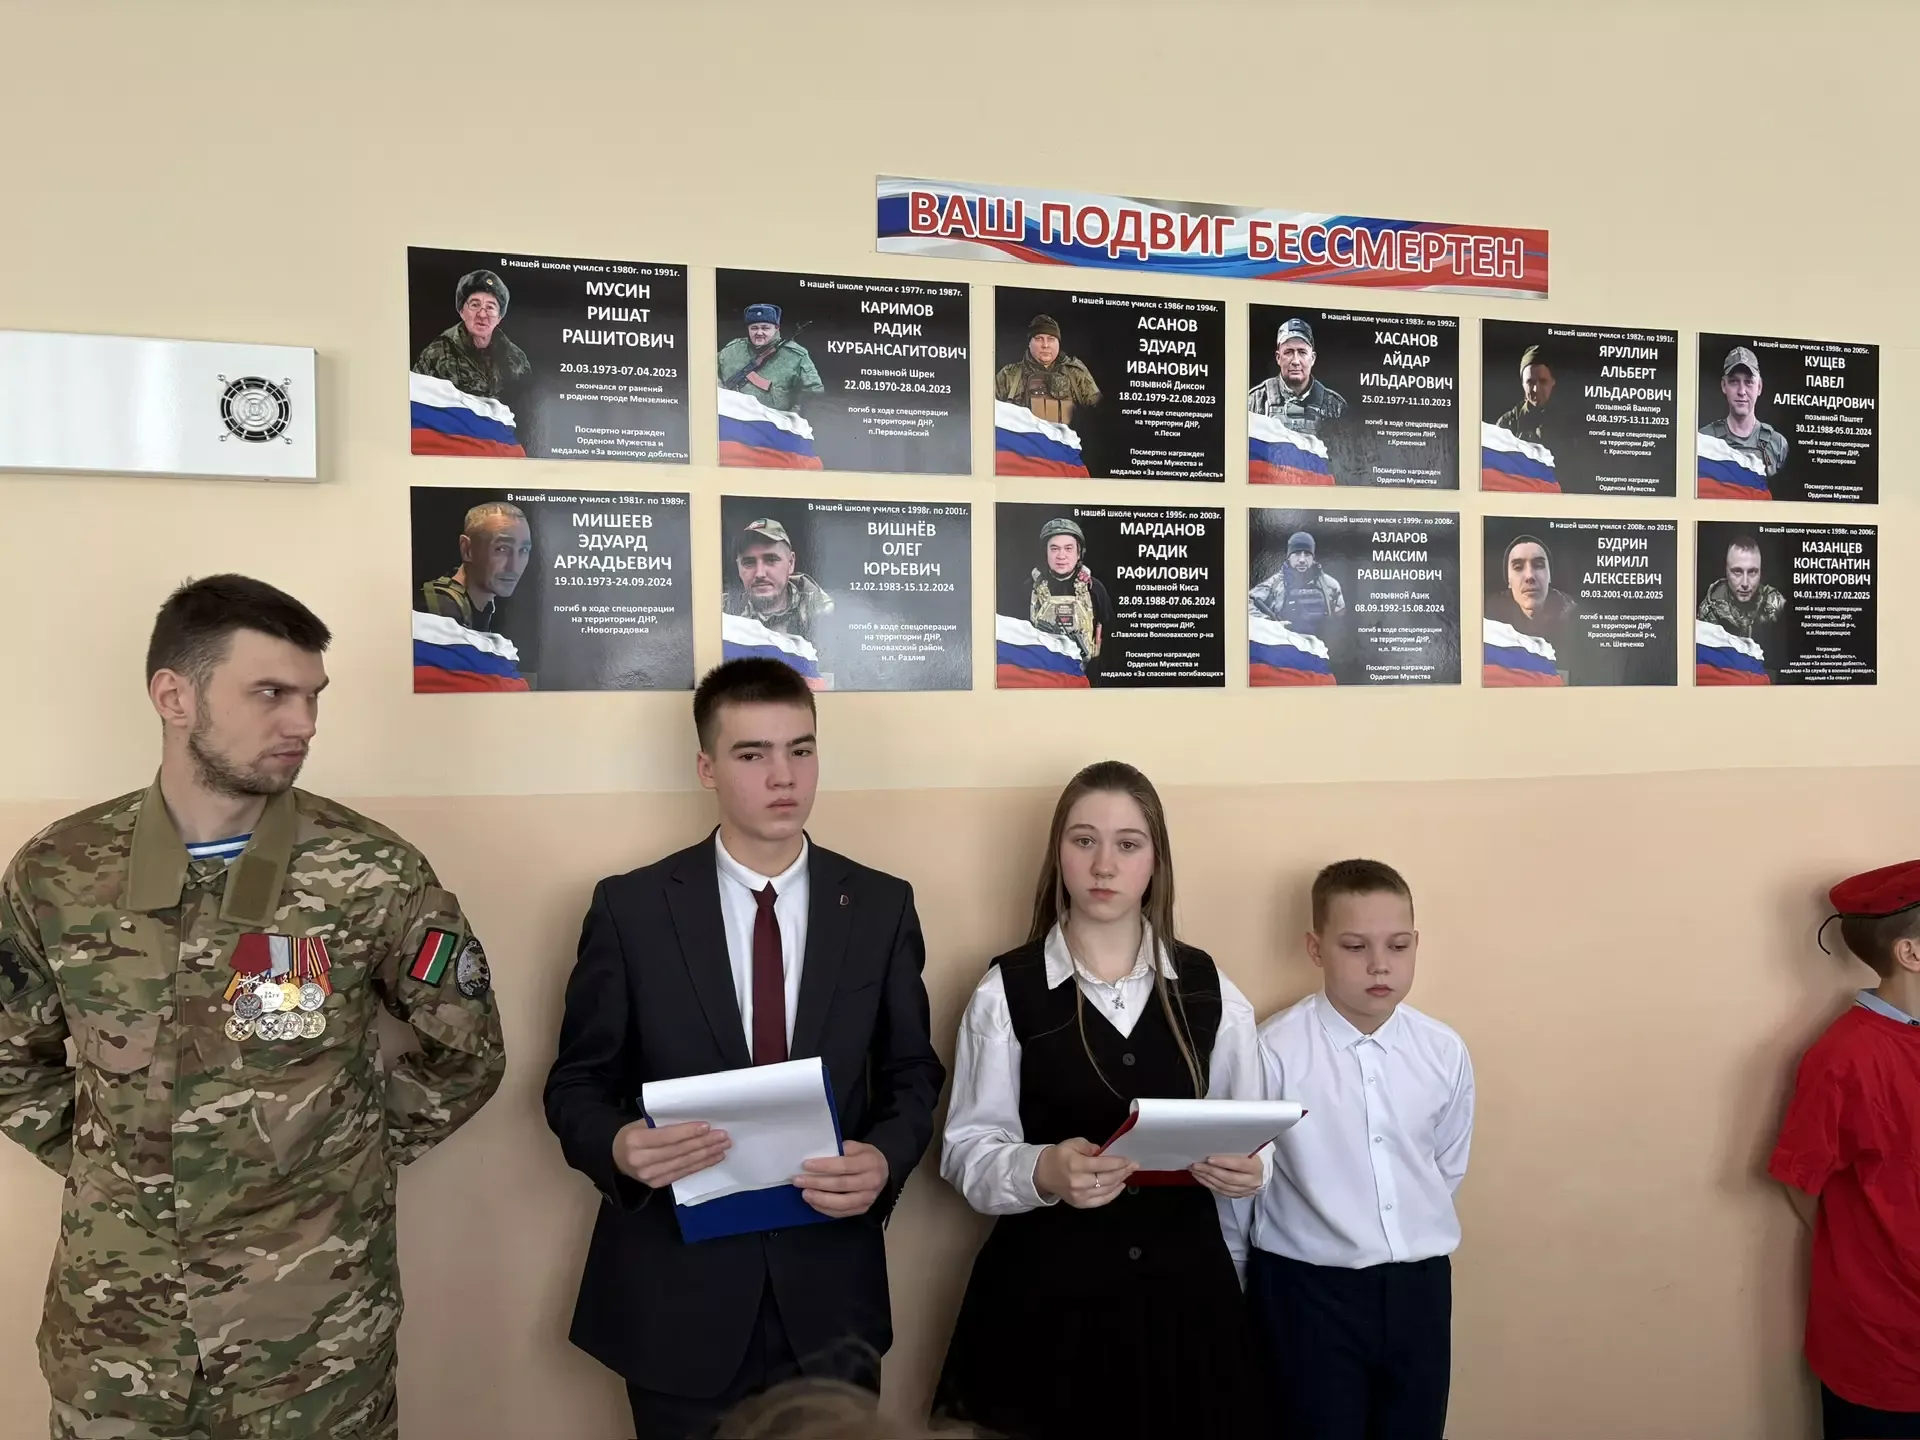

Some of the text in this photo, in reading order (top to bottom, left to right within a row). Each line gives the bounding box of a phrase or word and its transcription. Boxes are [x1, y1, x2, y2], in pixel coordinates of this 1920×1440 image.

[910, 191, 1524, 279] ВАШ ПОДВИГ БЕССМЕРТЕН
[501, 258, 508, 267] В
[509, 260, 540, 268] нашей
[541, 262, 571, 271] школе
[572, 264, 604, 272] учился
[612, 265, 639, 274] 1980г.
[640, 268, 653, 276] по
[654, 268, 680, 277] 1991г.
[586, 281, 650, 299] МУСИН
[799, 279, 806, 287] В
[807, 280, 835, 289] нашей
[836, 283, 864, 291] школе
[864, 285, 893, 293] учился
[901, 285, 925, 295] 1977г.
[926, 288, 938, 296] по
[939, 288, 963, 297] 1987г.
[587, 305, 651, 323] РИШАТ
[861, 300, 934, 317] КАРИМОВ
[873, 321, 922, 338] РАДИК
[1137, 316, 1198, 332] АСАНОВ
[562, 328, 674, 349] РАШИТОВИЧ
[1374, 331, 1439, 348] ХАСАНОВ
[827, 340, 967, 360] КУРБАНСАГИТОВИЧ
[1139, 338, 1197, 358] ЭДУАРД
[1599, 345, 1658, 360] ЯРУЛЛИН
[1382, 350, 1431, 370] АЙДАР
[1804, 355, 1846, 371] КУЩЕВ
[560, 363, 677, 378] 20.03.1973-07.04.2023
[860, 368, 935, 380] позывной Шрек
[1127, 360, 1209, 377] ИВАНОВИЧ
[1600, 365, 1657, 380] АЛЬБЕРТ
[575, 383, 617, 391] скончался
[628, 385, 663, 393] ранений
[844, 379, 951, 394] 22.08.1970-28.04.2023
[1129, 379, 1205, 391] позывной Диксон
[1360, 372, 1453, 390] ИЛЬДАРОВИЧ
[1806, 374, 1844, 389] ПАВЕЛ
[600, 395, 628, 403] городе
[630, 395, 679, 404] Мензелинск
[1119, 391, 1216, 405] 18.02.1979-22.08.2023
[1362, 394, 1452, 407] 25.02.1977-11.10.2023
[1584, 385, 1672, 402] ИЛЬДАРОВИЧ
[1773, 392, 1875, 411] АЛЕКСАНДРОВИЧ
[896, 408, 948, 417] спецоперации
[1586, 414, 1670, 426] 04.08.1975-13.11.2023
[873, 418, 916, 426] территории
[1795, 423, 1873, 436] 30.12.1988-05.01.2024
[575, 425, 665, 437] Посмертно награжден
[577, 436, 615, 446] Орденом
[616, 438, 657, 447] Мужества
[551, 447, 590, 455] медалью
[607, 450, 647, 458] воинскую
[507, 493, 514, 501] В
[515, 493, 546, 502] нашей
[578, 496, 610, 504] учился
[619, 496, 646, 504] 1981г.
[661, 497, 686, 505] 1989г.
[808, 503, 814, 511] В
[815, 503, 843, 511] нашей
[844, 505, 871, 513] школе
[872, 506, 900, 514] учился
[908, 506, 932, 515] 1998г.
[945, 506, 969, 515] 2001г.
[572, 513, 653, 528] МИШЕЕВ
[867, 520, 937, 537] ВИШНЁВ
[1120, 522, 1206, 539] МАРДАНОВ
[578, 534, 648, 552] ЭДУАРД
[1371, 531, 1428, 544] АЗЛАРОВ
[1598, 537, 1648, 552] БУДРИН
[882, 542, 923, 557] ОЛЕГ
[1138, 544, 1188, 561] РАДИК
[1372, 549, 1428, 562] МАКСИМ
[1802, 541, 1863, 557] КАЗАНЦЕВ
[554, 554, 672, 573] АРКАДЬЕВИЧ
[864, 561, 941, 576] ЮРЬЕВИЧ
[1597, 554, 1649, 568] КИРИЛЛ
[1794, 557, 1871, 570] КОНСТАНТИН
[1117, 565, 1209, 580] РАФИЛОВИЧ
[1357, 568, 1442, 581] РАВШАНОВИЧ
[1582, 572, 1662, 585] АЛЕКСЕЕВИЧ
[1793, 572, 1871, 586] ВИКТОРОВИЧ
[554, 576, 672, 587] 19.10.1973-24.09.2024
[850, 582, 955, 592] 12.02.1983-15.12.2024
[1135, 582, 1199, 592] позывной Киса
[1118, 595, 1216, 606] 28.09.1988-07.06.2024
[1580, 590, 1664, 600] 09.03.2001-01.02.2025
[1793, 590, 1871, 600] 04.01.1991-17.02.2025
[554, 604, 580, 613] погиб
[589, 606, 610, 614] ходе
[611, 606, 675, 614] спецоперации
[1354, 603, 1445, 613] 08.09.1992-15.08.2024
[584, 616, 636, 625] территории
[1125, 651, 1163, 659] Посмертно
[1126, 660, 1159, 669] Орденом
[1159, 660, 1193, 669] Мужества
